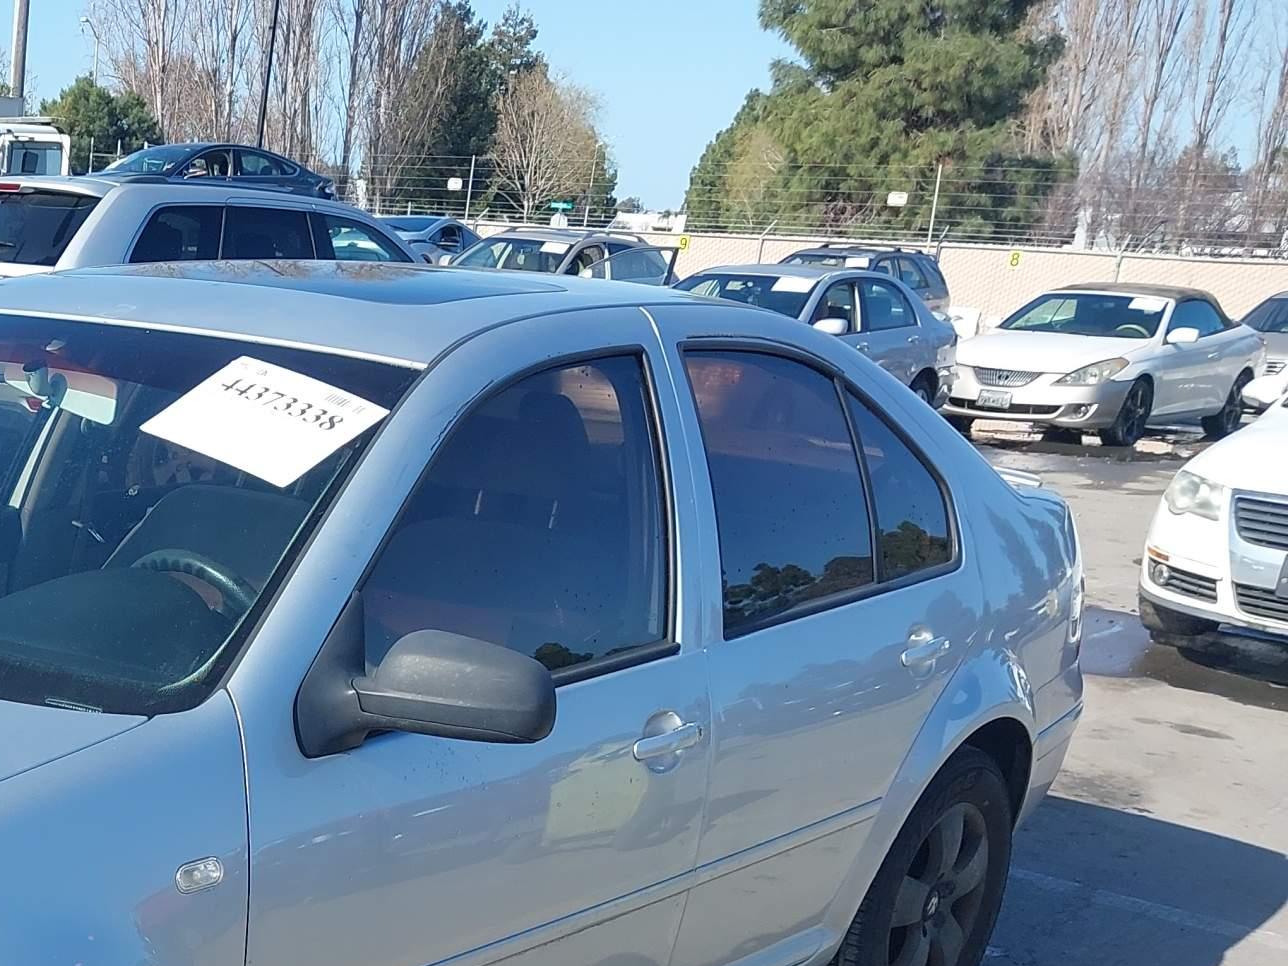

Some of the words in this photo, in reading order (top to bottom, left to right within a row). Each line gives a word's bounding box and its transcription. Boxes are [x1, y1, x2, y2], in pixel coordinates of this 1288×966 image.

[680, 237, 688, 250] 9
[1010, 252, 1020, 266] 8
[221, 378, 344, 431] 44373338
